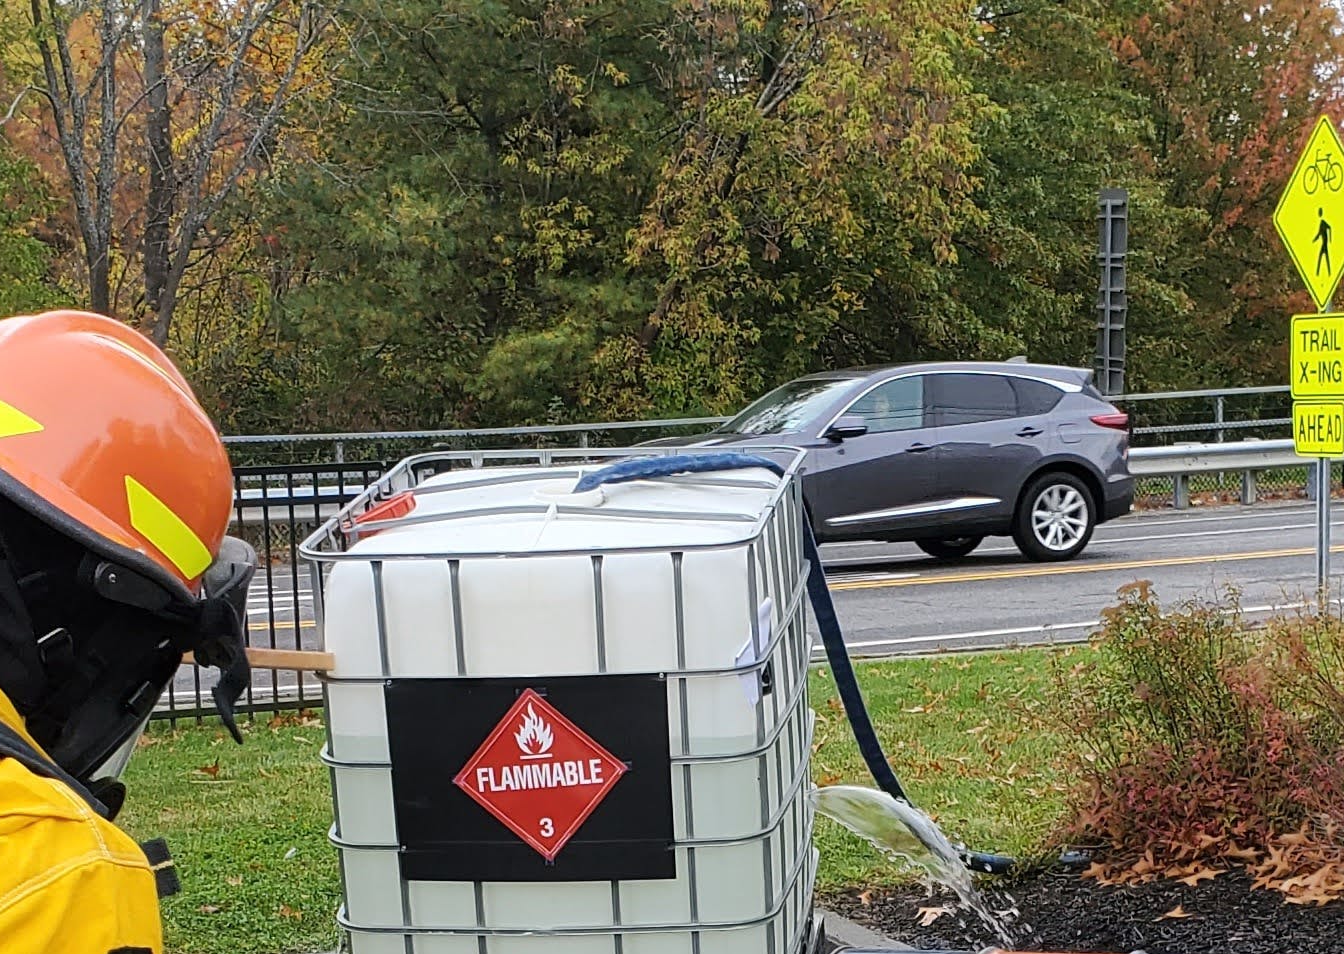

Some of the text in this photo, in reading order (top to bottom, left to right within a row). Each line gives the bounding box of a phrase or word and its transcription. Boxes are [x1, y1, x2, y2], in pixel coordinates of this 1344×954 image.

[1300, 329, 1341, 352] TRAIL
[1299, 360, 1342, 384] X-ING
[1299, 414, 1342, 443] AHEAD
[476, 758, 604, 793] FLAMMABLE
[539, 817, 555, 837] 3
